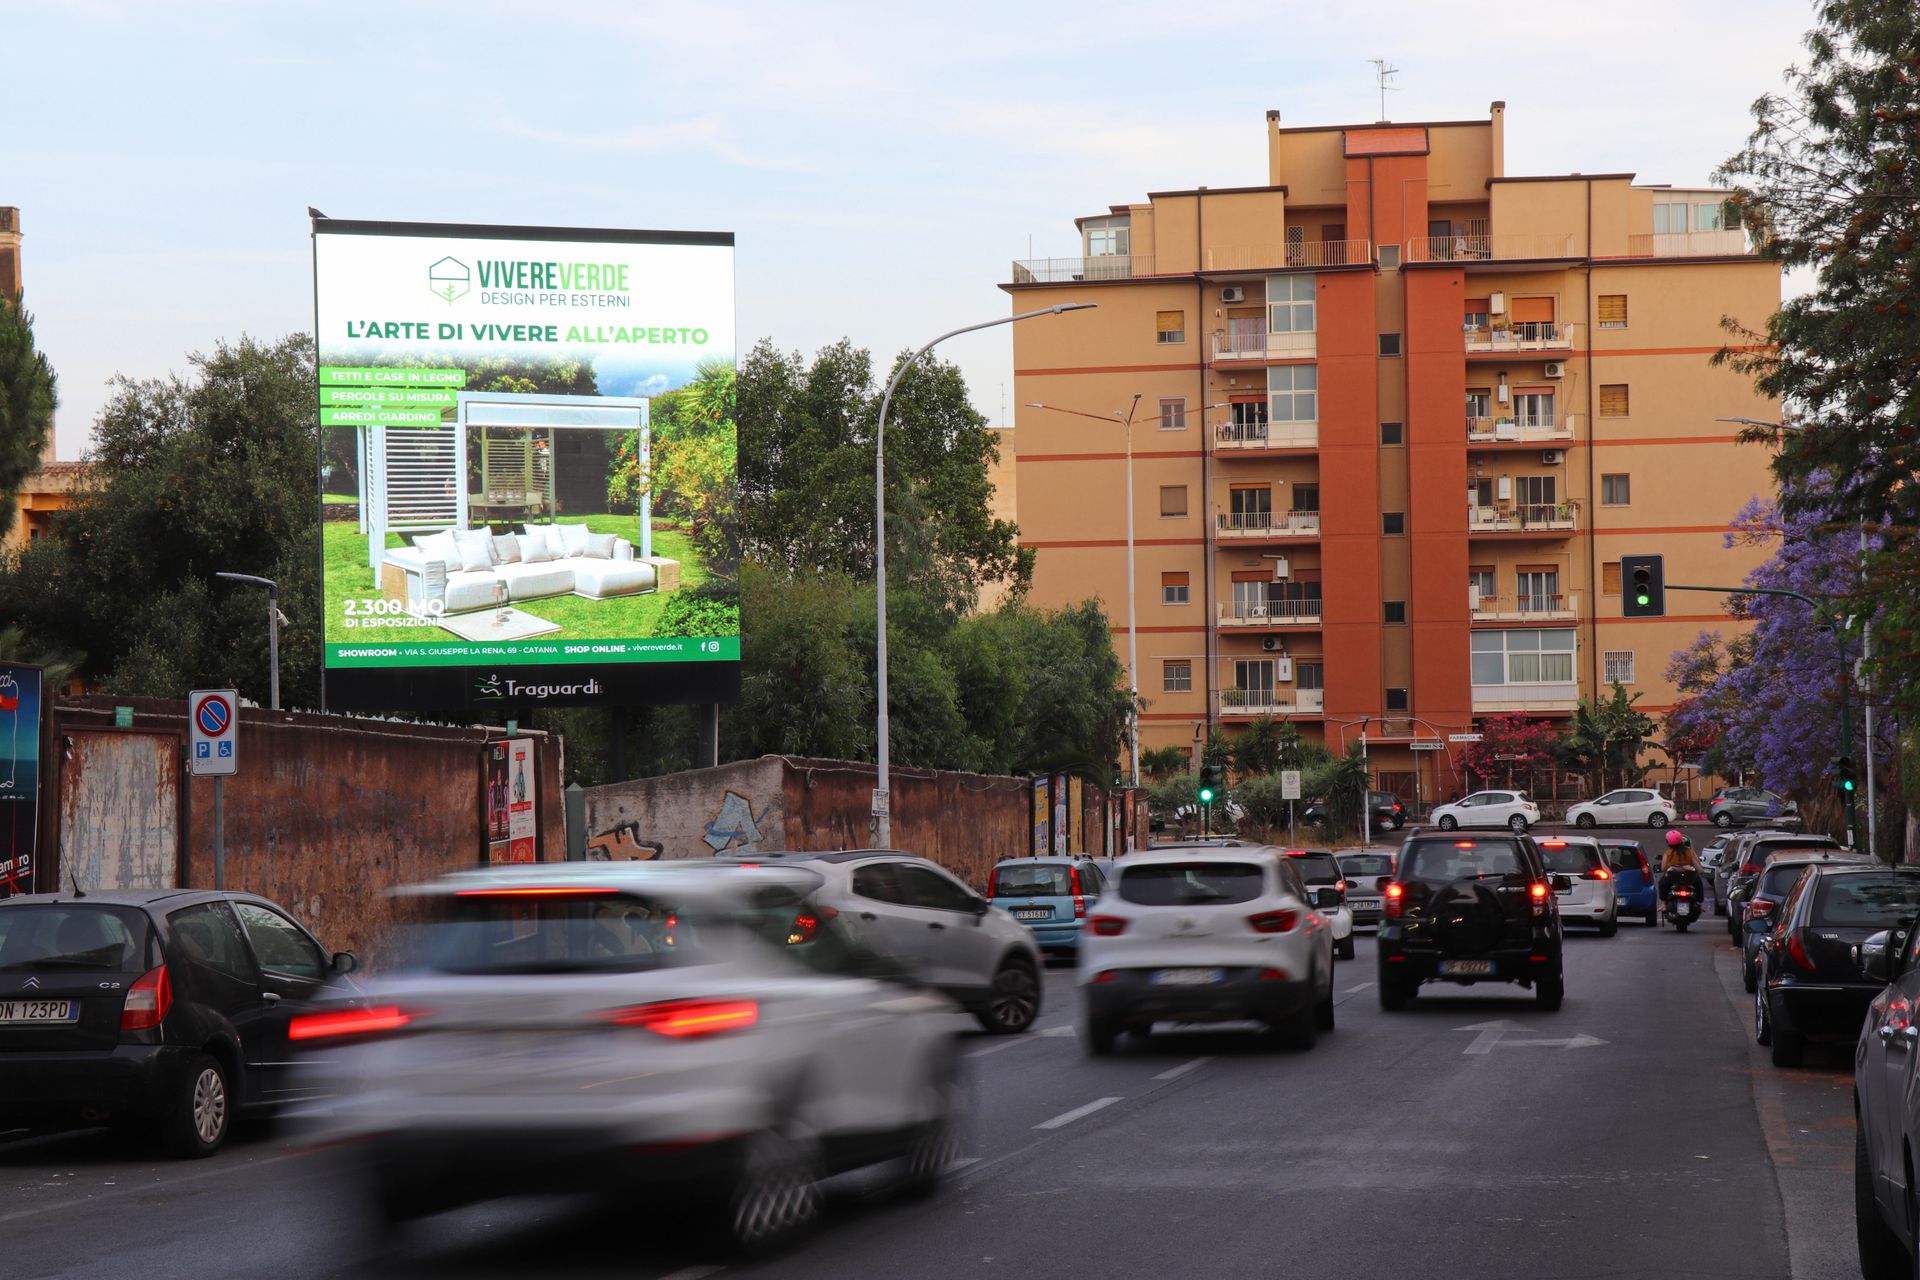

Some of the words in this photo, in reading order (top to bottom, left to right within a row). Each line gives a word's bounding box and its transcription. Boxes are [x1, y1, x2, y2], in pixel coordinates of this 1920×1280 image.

[477, 260, 629, 291] VIVEREVERDE
[481, 292, 535, 306] DESIGN
[539, 293, 567, 306] PER
[571, 294, 630, 307] ESTERNI
[347, 320, 430, 339] L'ARTE
[438, 323, 463, 340] DI
[471, 324, 558, 342] VIVERE
[565, 325, 709, 345] ALL'APERTO
[331, 371, 362, 381] TETTI
[364, 372, 373, 381] E
[375, 372, 405, 382] CASE
[408, 373, 420, 382] IN
[423, 373, 462, 383] LEGNO
[331, 391, 385, 401] PERGOLE
[388, 392, 403, 402] SU
[406, 392, 451, 402] MISURA
[332, 411, 376, 421] ARREDI
[378, 412, 436, 422] GIARDINO
[344, 598, 402, 615] 2.300
[345, 618, 359, 627] DI
[361, 617, 442, 627] ESPOSIZIONE
[338, 649, 397, 657] SHOWROOM
[404, 648, 419, 656] VIA
[420, 648, 427, 656] S.
[470, 647, 481, 655] LA
[482, 647, 506, 656] RENA,
[523, 646, 558, 654] CATANIA
[564, 645, 590, 654] SHOP
[592, 645, 625, 653] ONLINE
[632, 643, 683, 651] vivereverde.it
[505, 678, 598, 698] Traguardi
[199, 744, 207, 757] P
[22, 1001, 69, 1019] 123PD
